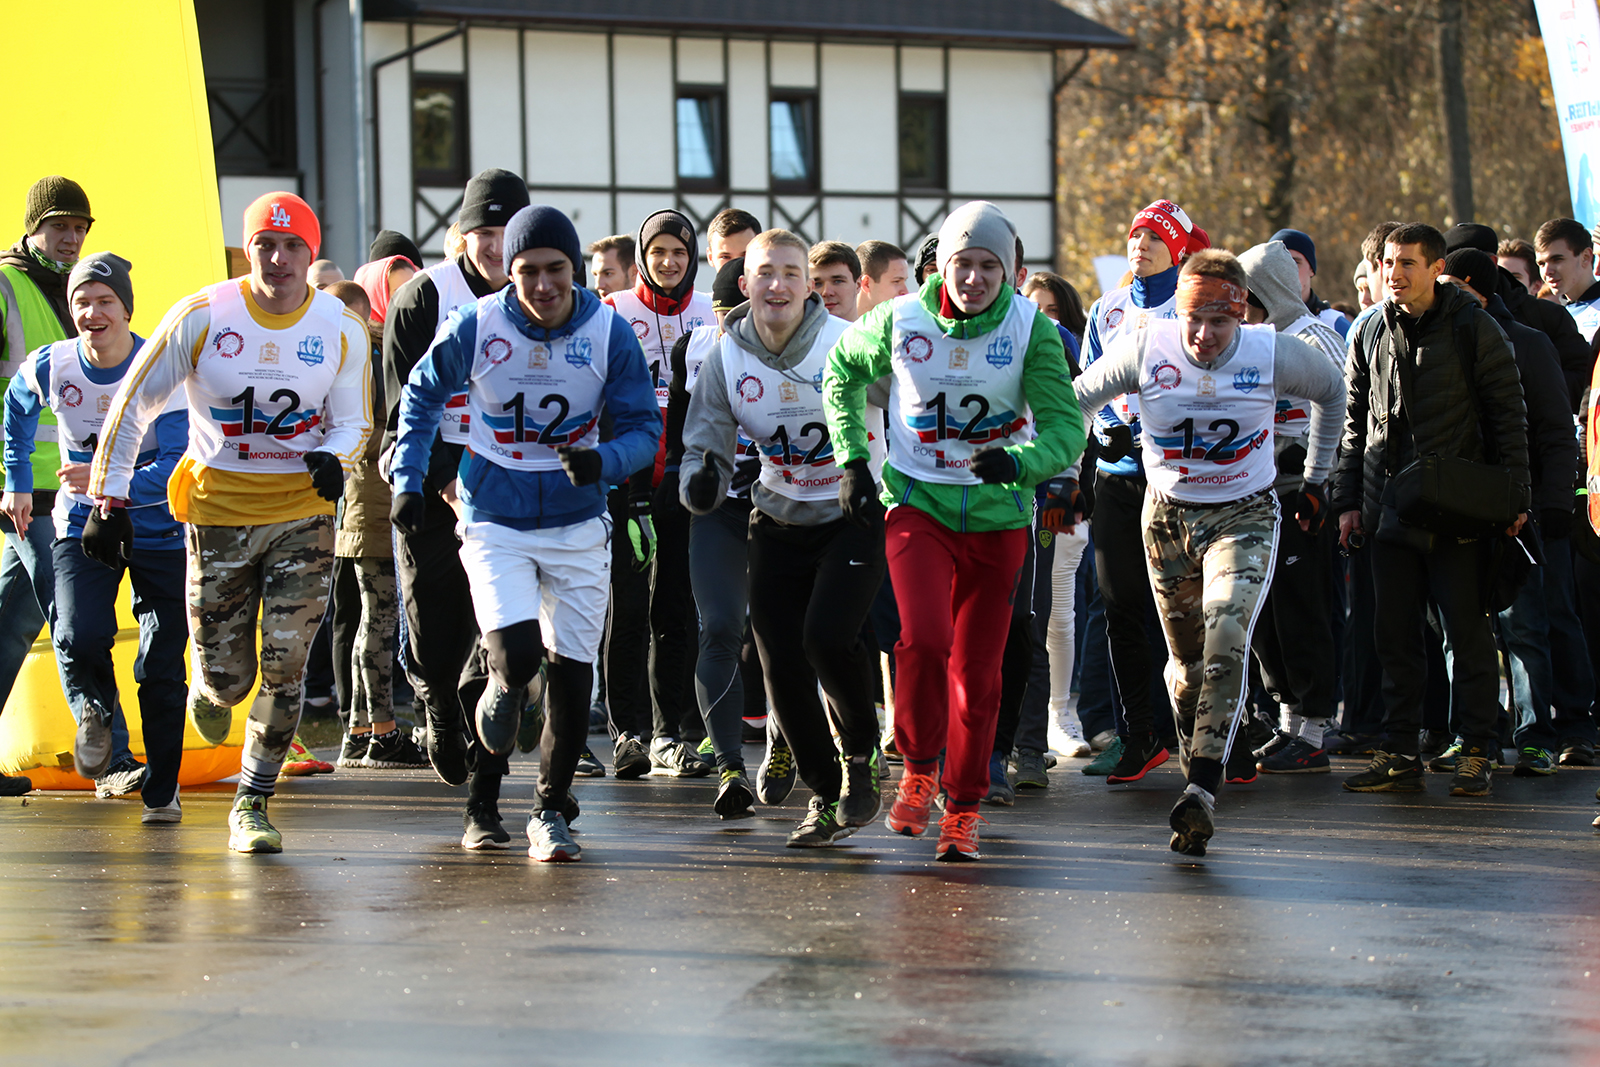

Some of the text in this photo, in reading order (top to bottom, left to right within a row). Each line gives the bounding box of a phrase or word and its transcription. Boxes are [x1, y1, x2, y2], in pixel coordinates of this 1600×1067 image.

[270, 203, 291, 228] LA
[1134, 211, 1179, 240] OSCOW
[231, 386, 301, 435] 12
[442, 412, 460, 423] ОС
[502, 392, 570, 444] 12
[926, 391, 990, 441] 12
[1278, 409, 1288, 423] 5
[578, 422, 589, 438] 3
[1001, 421, 1012, 439] 6
[1172, 417, 1240, 460] 12
[769, 421, 833, 467] 12
[913, 446, 936, 457] РОС
[249, 450, 307, 460] МОЛОДЕЖ
[791, 475, 844, 488] МОЛОДЕЖ
[1187, 471, 1249, 485] МОЛОДЕЖЬ
